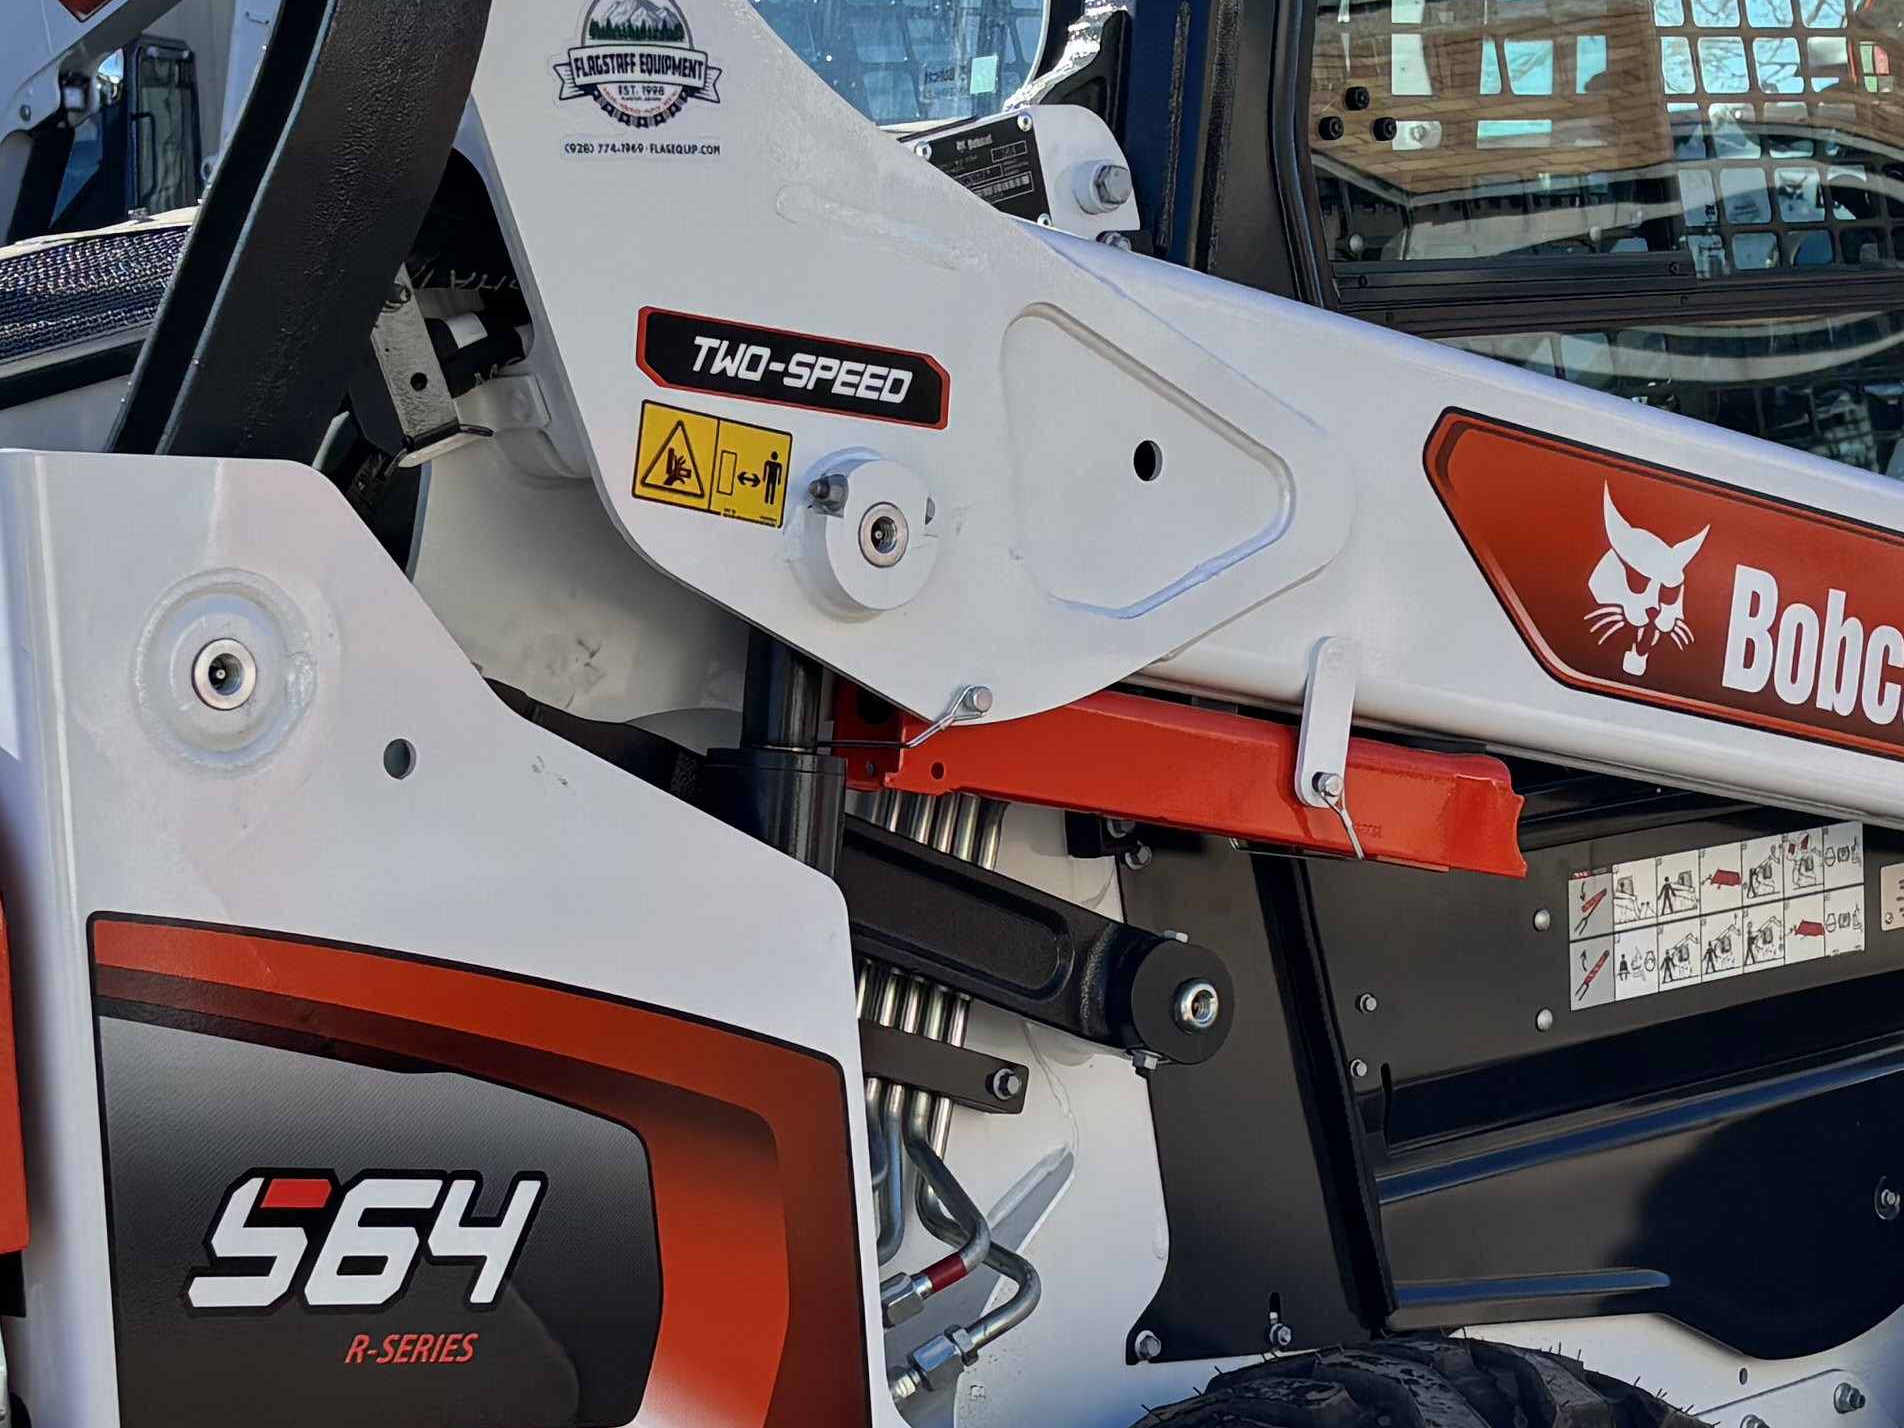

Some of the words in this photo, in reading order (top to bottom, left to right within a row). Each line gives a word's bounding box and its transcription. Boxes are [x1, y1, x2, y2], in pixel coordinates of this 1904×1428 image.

[574, 53, 636, 78] FLAGSTAFF
[639, 53, 704, 80] EQUIPMENT
[618, 85, 639, 95] EST.
[564, 143, 594, 154] (928)
[693, 335, 913, 405] TWO-SPEED
[190, 1174, 544, 1310] S64
[344, 1333, 479, 1365] R-SERIES
